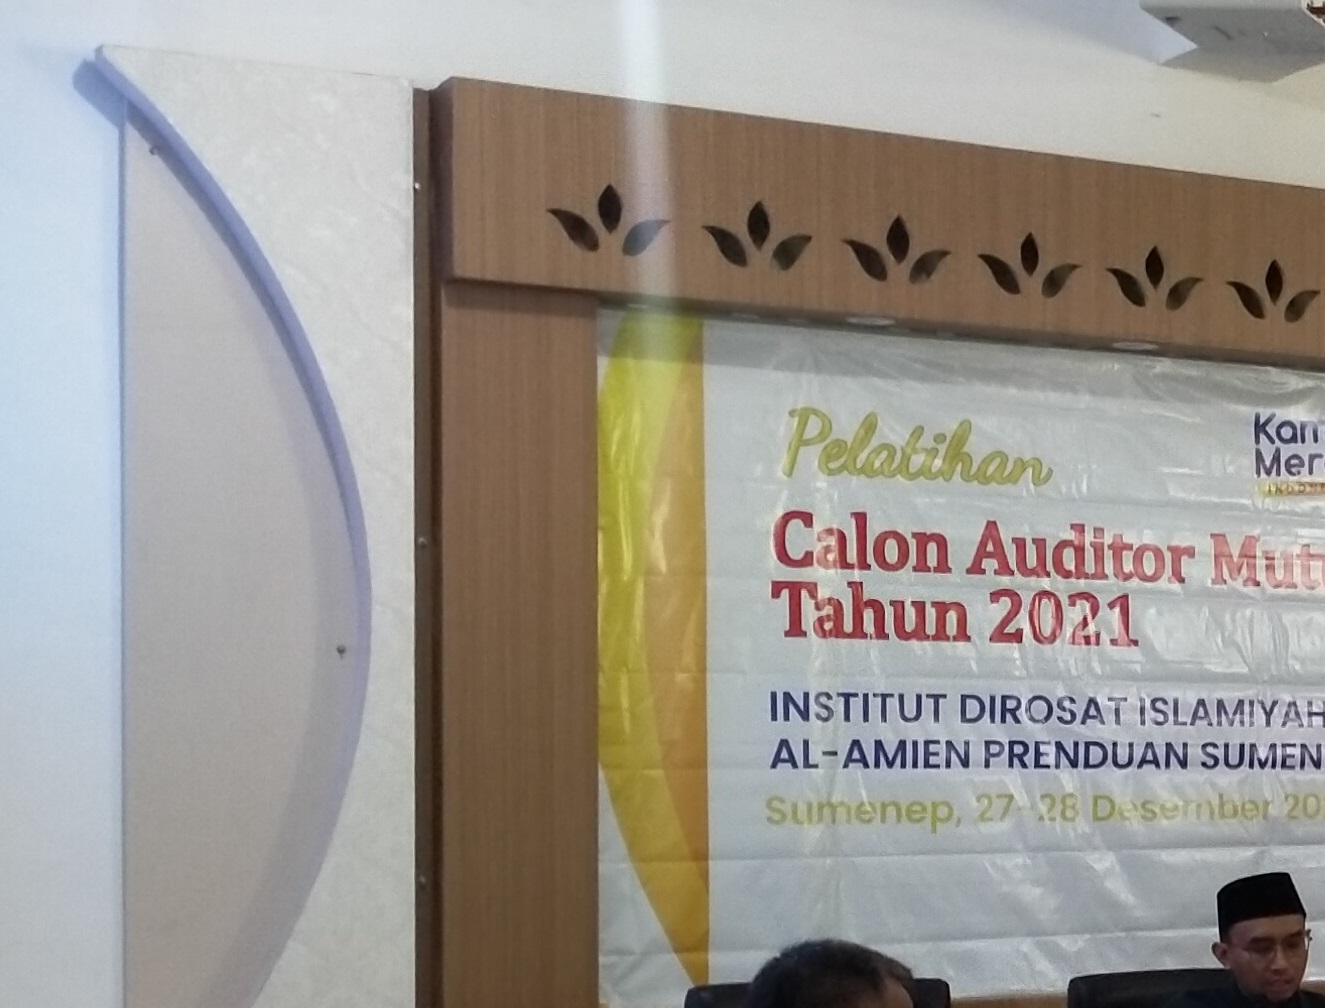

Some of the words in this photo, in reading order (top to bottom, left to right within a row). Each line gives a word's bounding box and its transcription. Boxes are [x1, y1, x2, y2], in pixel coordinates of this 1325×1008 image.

[782, 407, 1054, 487] Pelatihan
[772, 510, 953, 575] Calon
[966, 518, 1196, 585] Auditor
[770, 580, 972, 643] Tahun
[989, 588, 1140, 648] 2021
[769, 691, 948, 725] INSTITUT
[960, 693, 1129, 727] DIROSAT
[769, 737, 971, 771] AL-AMIEN
[983, 740, 1189, 771] PRENDUAN
[765, 795, 963, 834] Sumenep,
[1092, 792, 1272, 824] Desember
